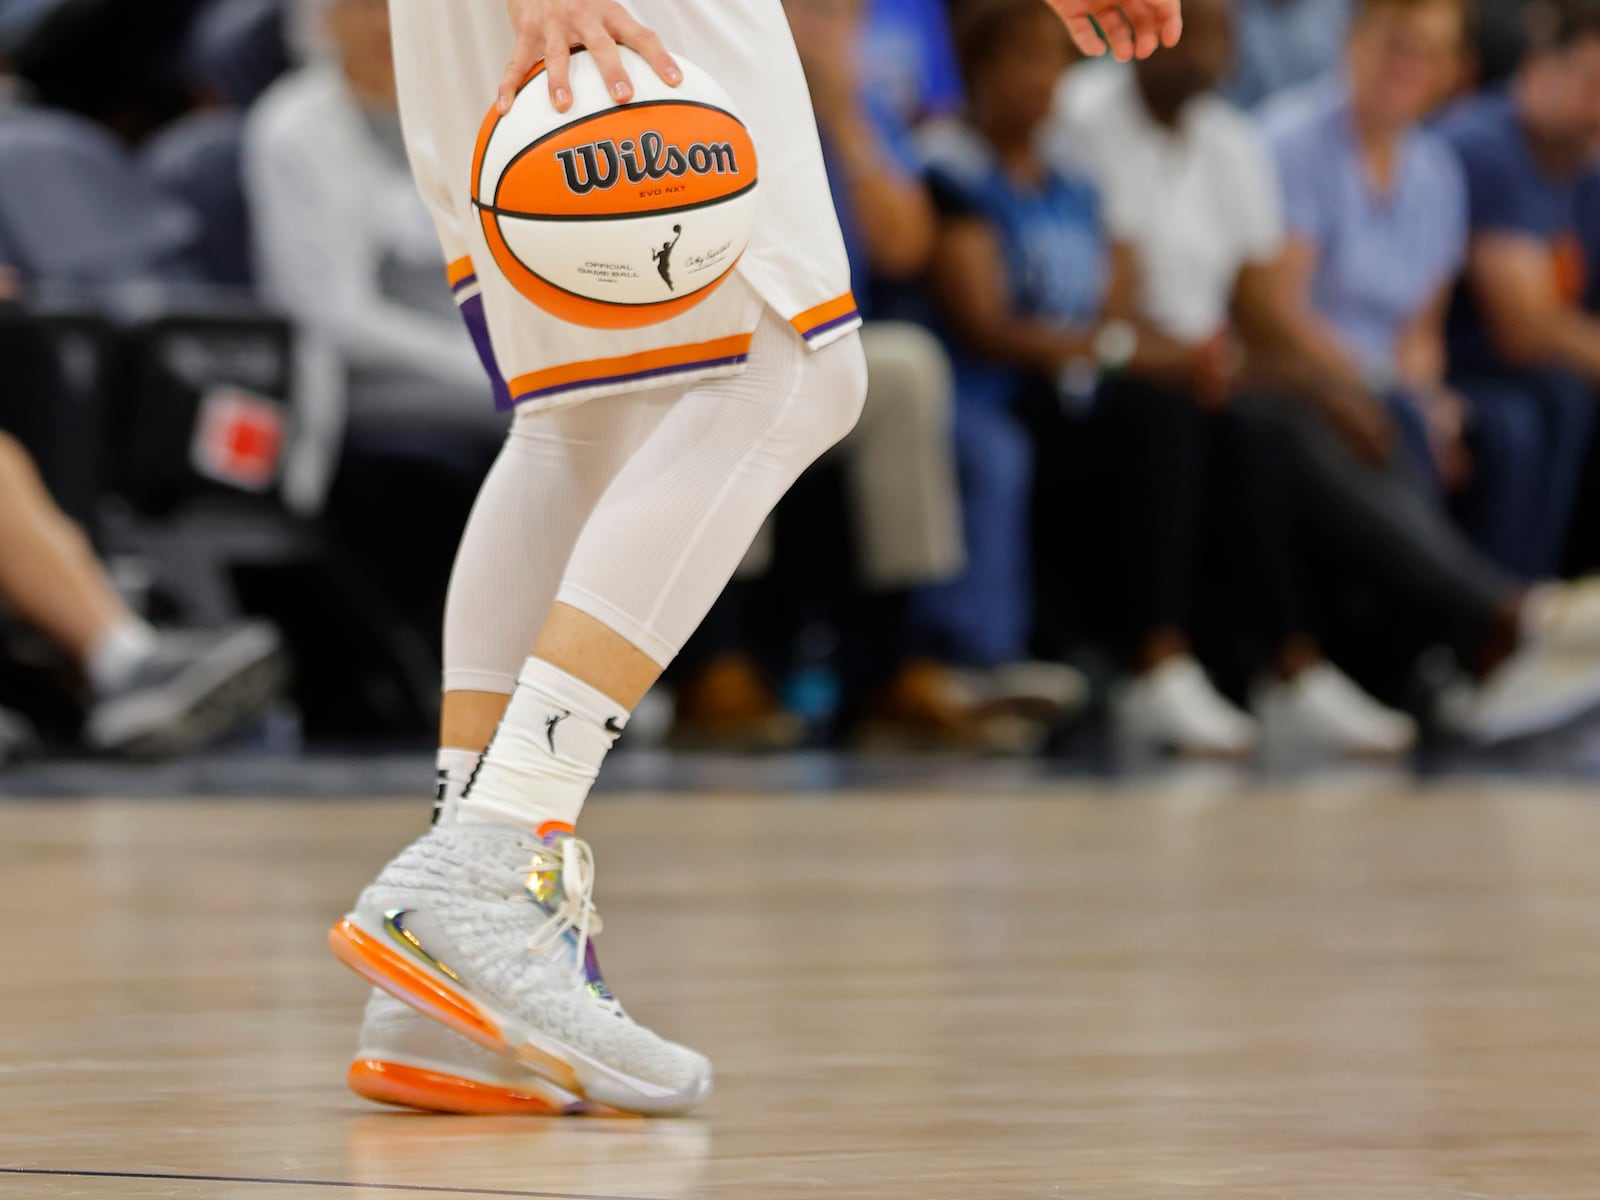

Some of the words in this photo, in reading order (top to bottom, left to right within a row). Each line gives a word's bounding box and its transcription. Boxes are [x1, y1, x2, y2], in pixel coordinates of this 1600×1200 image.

[555, 131, 739, 195] Wilson
[640, 189, 662, 198] EVO
[666, 185, 686, 193] NXT
[577, 267, 609, 276] GAME
[585, 262, 633, 270] OFFICIAL
